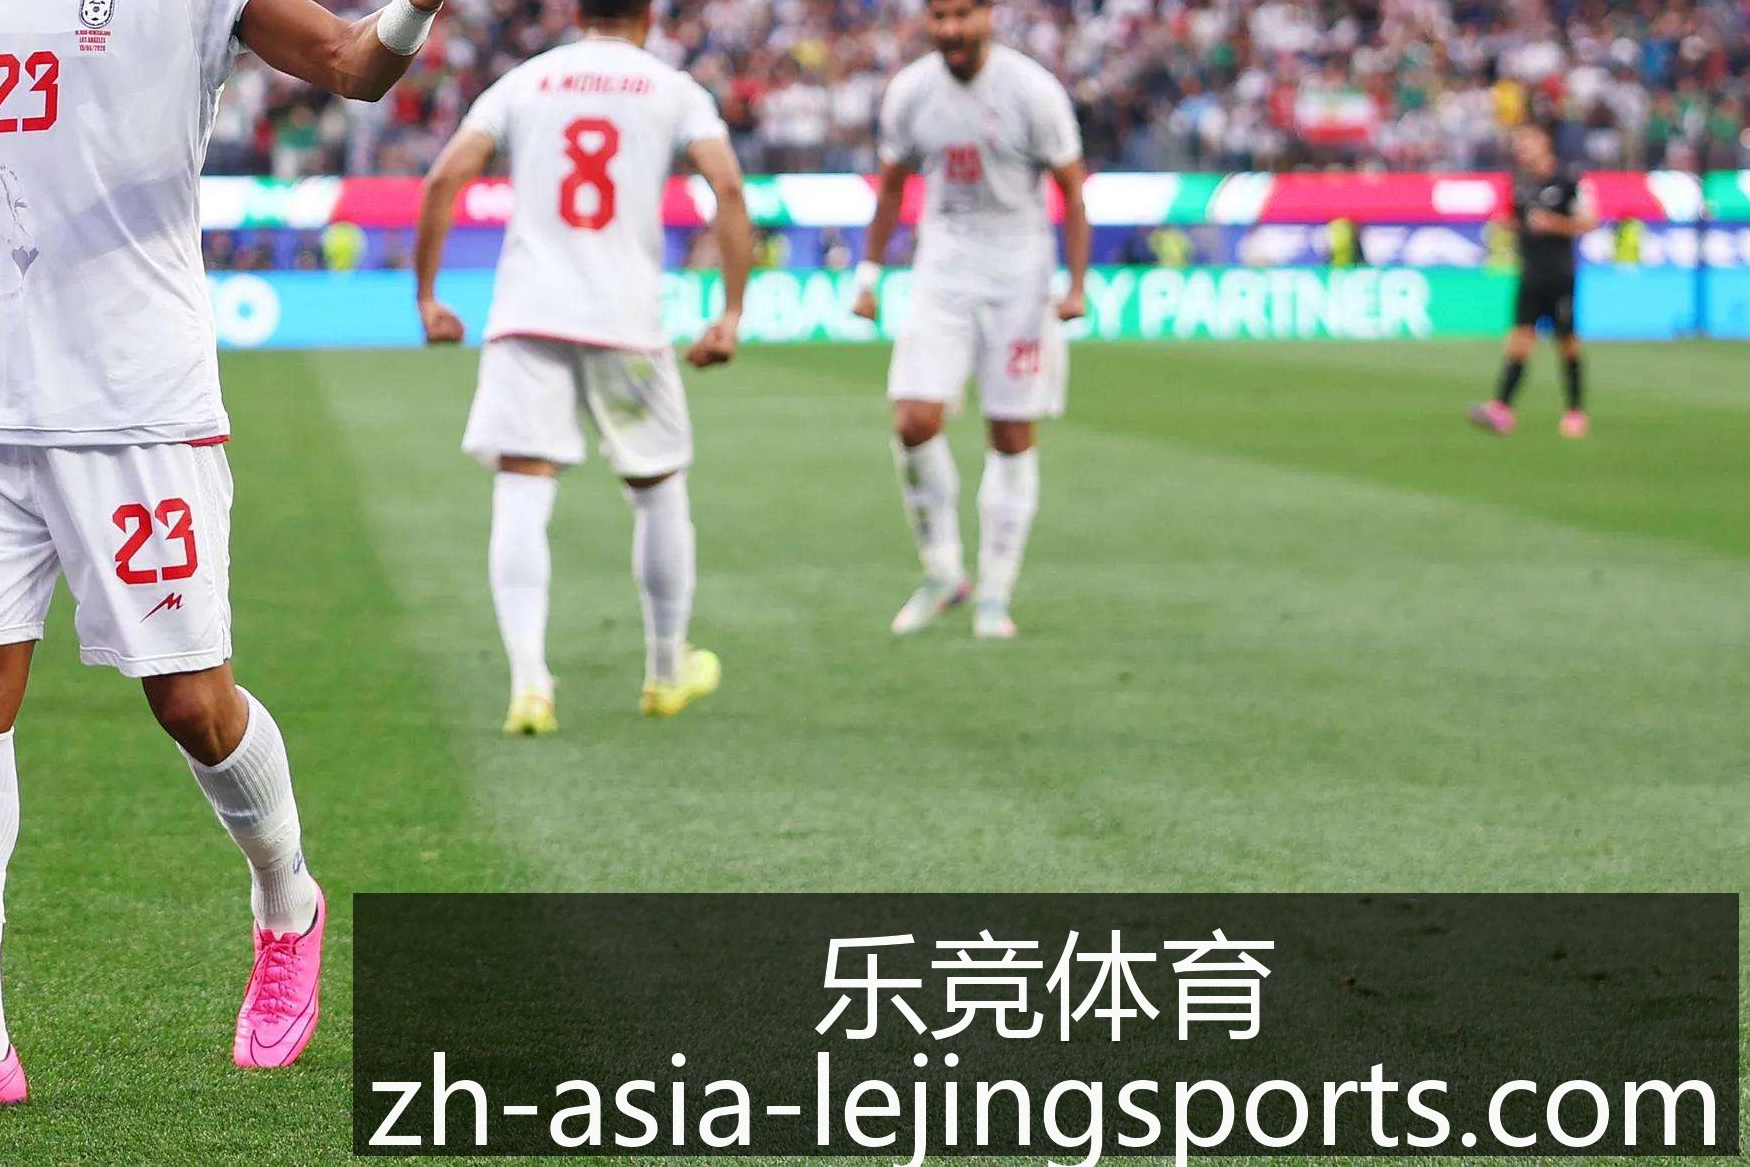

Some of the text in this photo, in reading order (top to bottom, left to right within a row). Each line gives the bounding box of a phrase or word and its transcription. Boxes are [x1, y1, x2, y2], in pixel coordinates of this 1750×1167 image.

[559, 117, 620, 231] 8
[1139, 269, 1432, 340] PARTNER
[113, 498, 198, 584] 23
